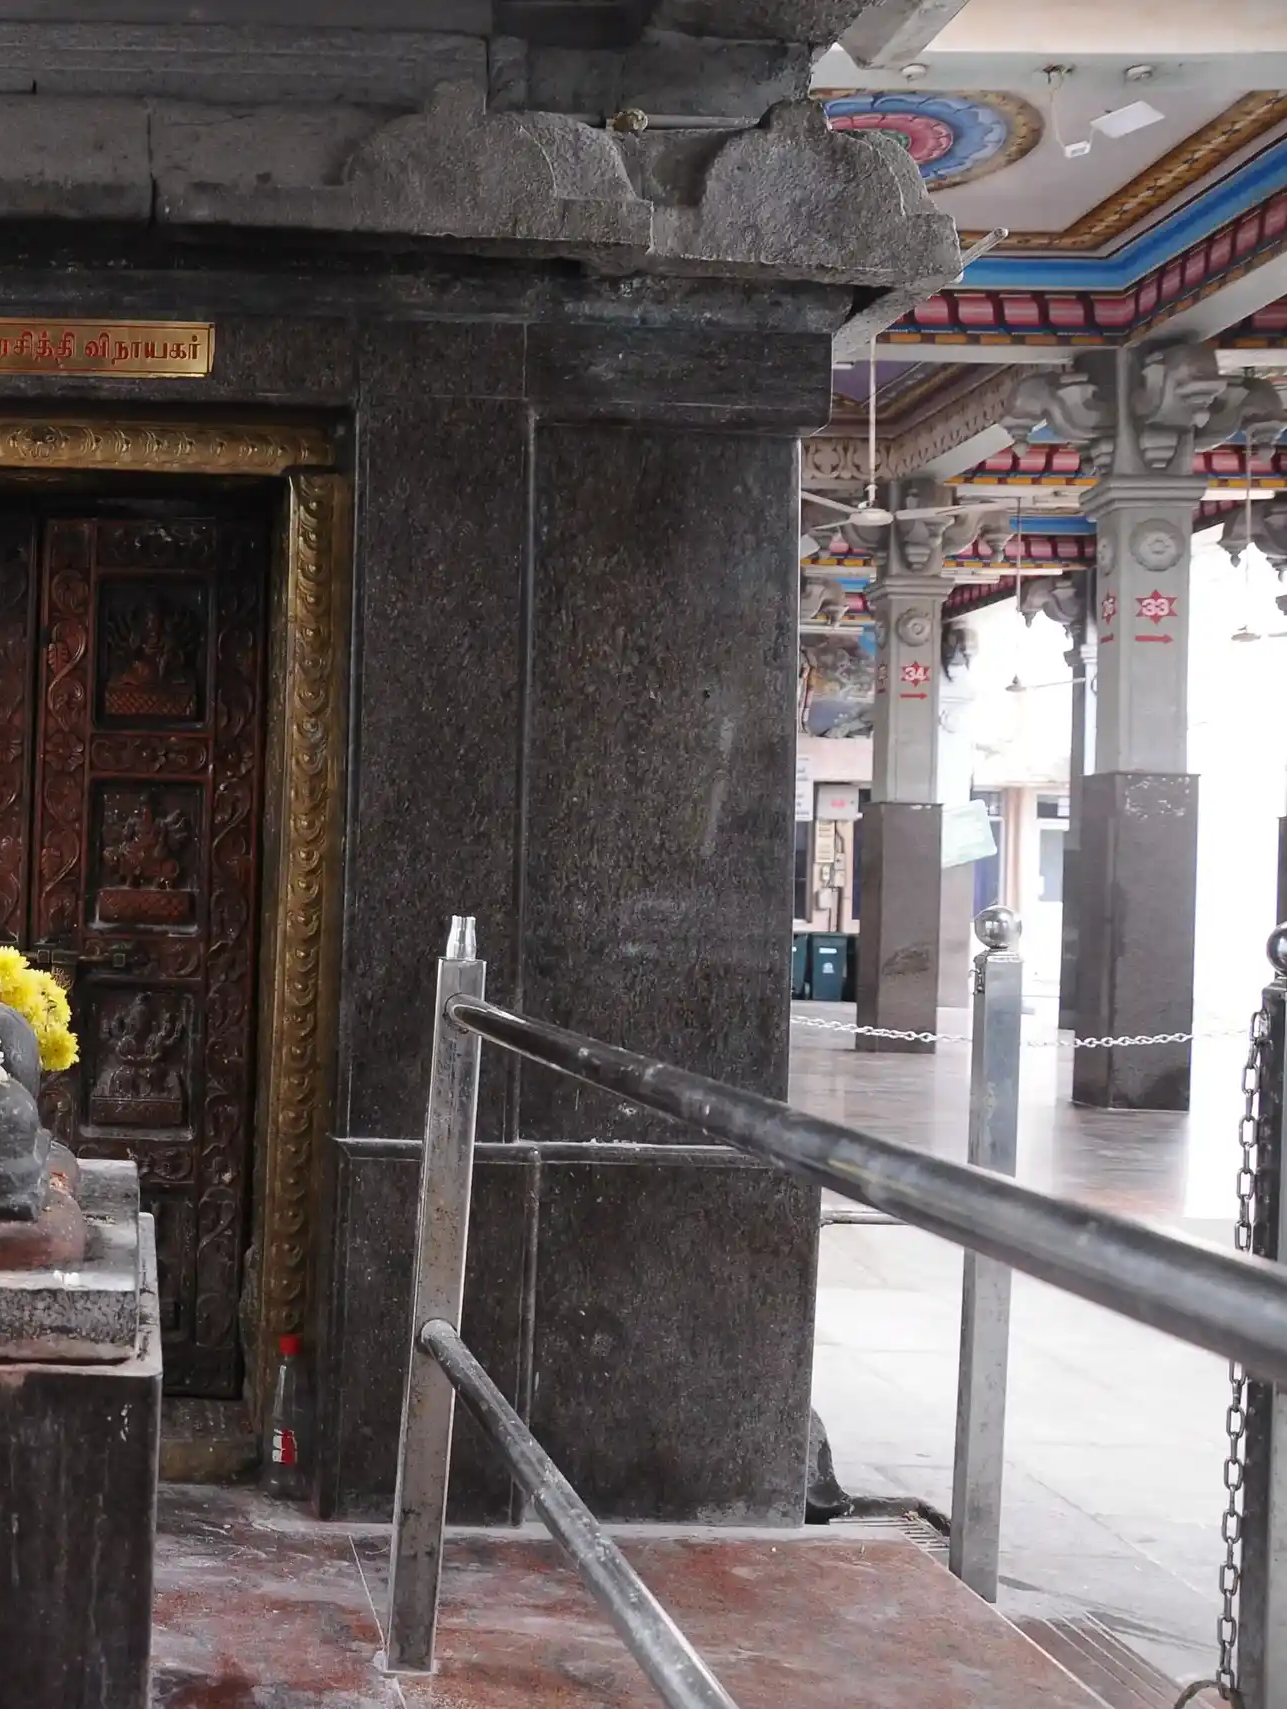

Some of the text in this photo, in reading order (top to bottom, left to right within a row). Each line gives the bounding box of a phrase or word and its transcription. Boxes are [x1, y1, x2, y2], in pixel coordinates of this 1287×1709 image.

[84, 332, 202, 365] விநாயகர்
[1141, 598, 1169, 616] 33
[904, 667, 927, 681] 34
